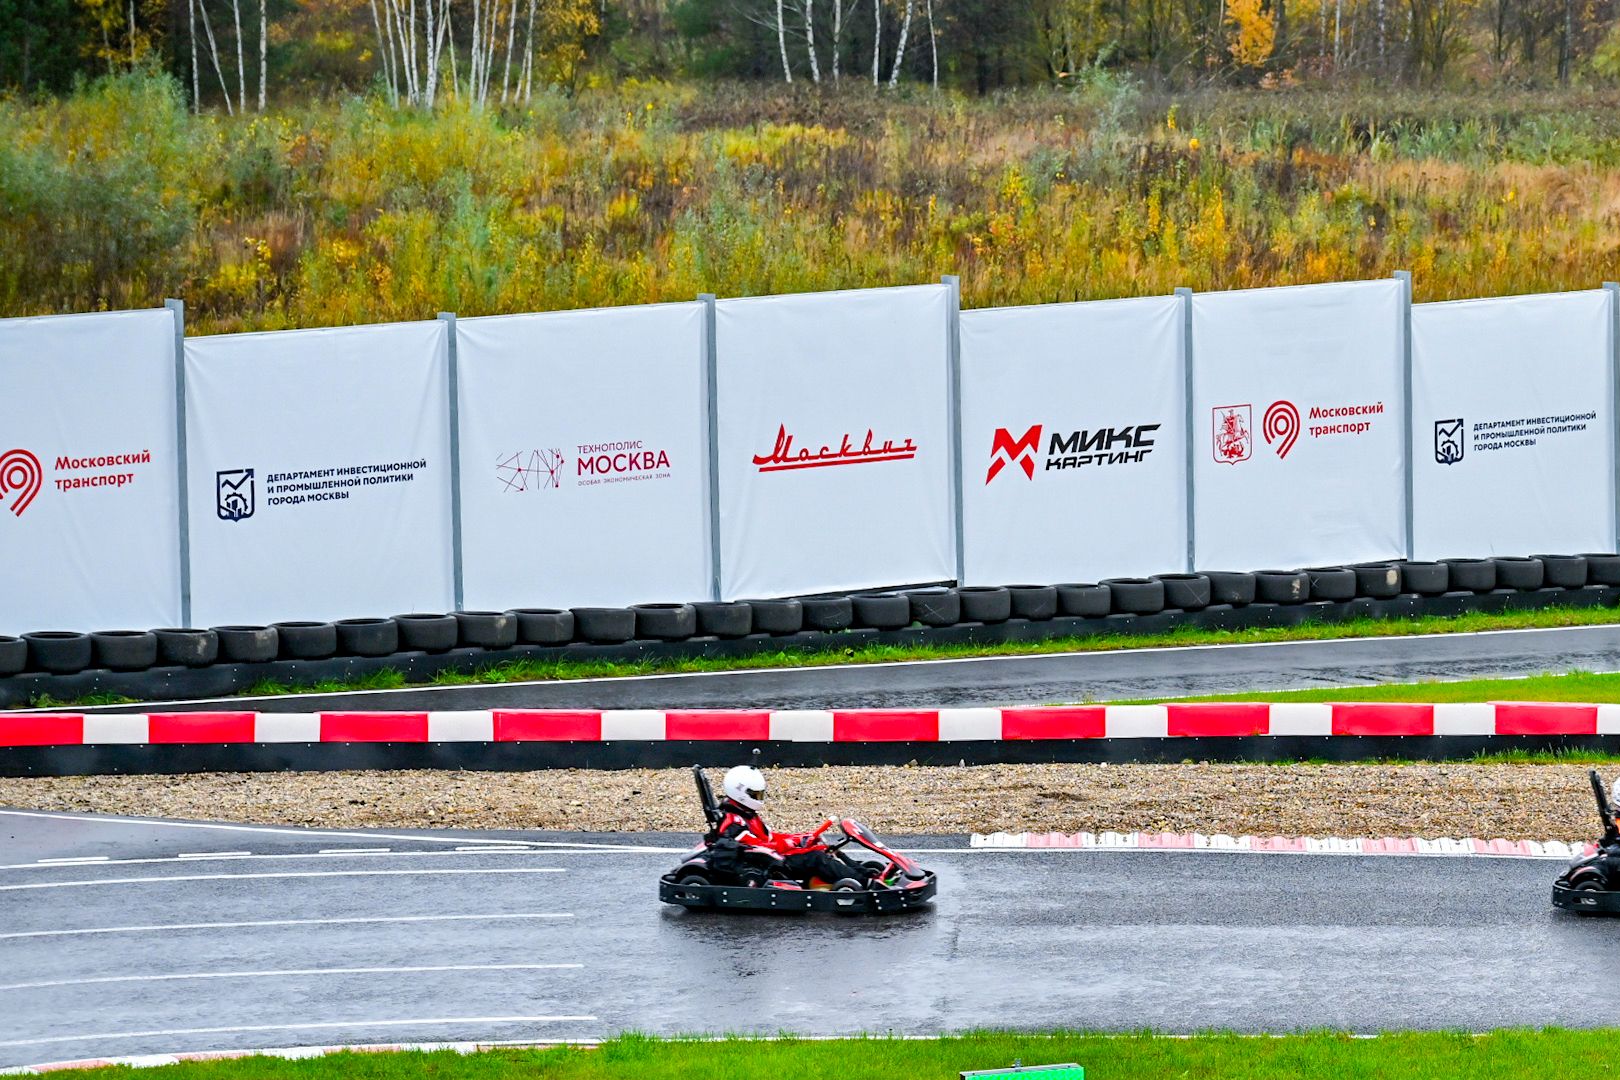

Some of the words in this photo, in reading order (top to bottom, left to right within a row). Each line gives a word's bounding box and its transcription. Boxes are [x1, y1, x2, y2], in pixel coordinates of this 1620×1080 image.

[1309, 402, 1383, 419] Московский
[1309, 422, 1370, 438] транспорт
[1474, 419, 1525, 431] ДЕПАРТАМЕНТ
[1527, 411, 1596, 425] ИНВЕСТИЦИОННОЙ
[1049, 424, 1161, 455] МИКС
[1481, 426, 1545, 439] ПРОМЫШЛЕННОЙ
[1547, 424, 1586, 434] ПОЛИТИКИ
[577, 441, 642, 454] ТЕХНОПОЛИС
[1474, 442, 1502, 451] ГОРОДА
[1504, 439, 1536, 448] МОСКВЫ
[55, 449, 150, 470] Московский
[578, 450, 670, 476] МОСКВА
[1046, 450, 1152, 470] КАРТИНГ
[267, 469, 335, 483] ДЕПАРТАМЕНТ
[337, 459, 426, 475] ИНВЕСТИЦИОННОЙ
[55, 474, 133, 492] транспорт
[277, 477, 361, 493] ПРОМЫШЛЕННОЙ
[363, 473, 413, 485] ПОЛИТИКИ
[268, 496, 305, 505] ГОРОДА
[308, 491, 349, 502] МОСКВЫ
